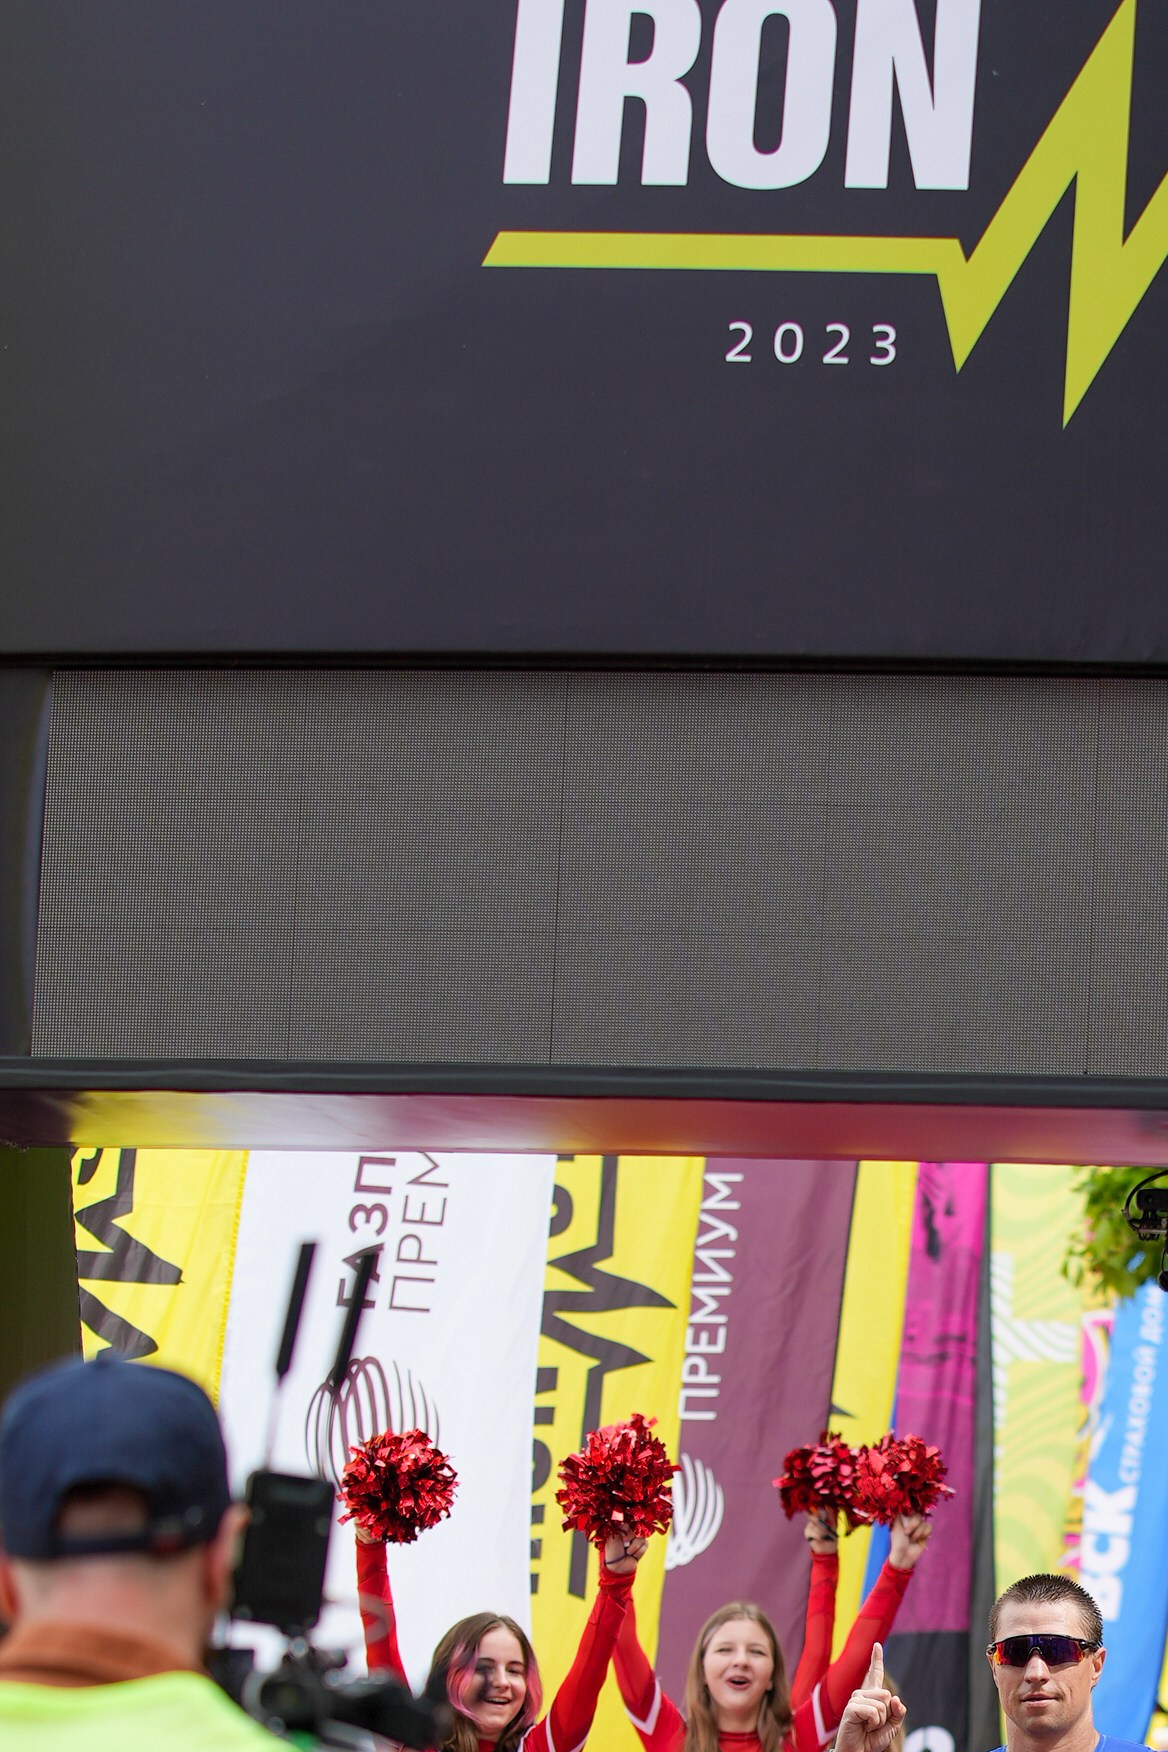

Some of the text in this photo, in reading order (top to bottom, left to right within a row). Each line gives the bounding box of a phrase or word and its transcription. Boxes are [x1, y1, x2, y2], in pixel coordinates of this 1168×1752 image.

[502, 0, 982, 192] IRON
[724, 320, 900, 366] 2023
[679, 1172, 744, 1421] ПРЕМИУМ
[1081, 1484, 1139, 1622] ВСК
[1118, 1346, 1158, 1486] СТРАХОВОЙ
